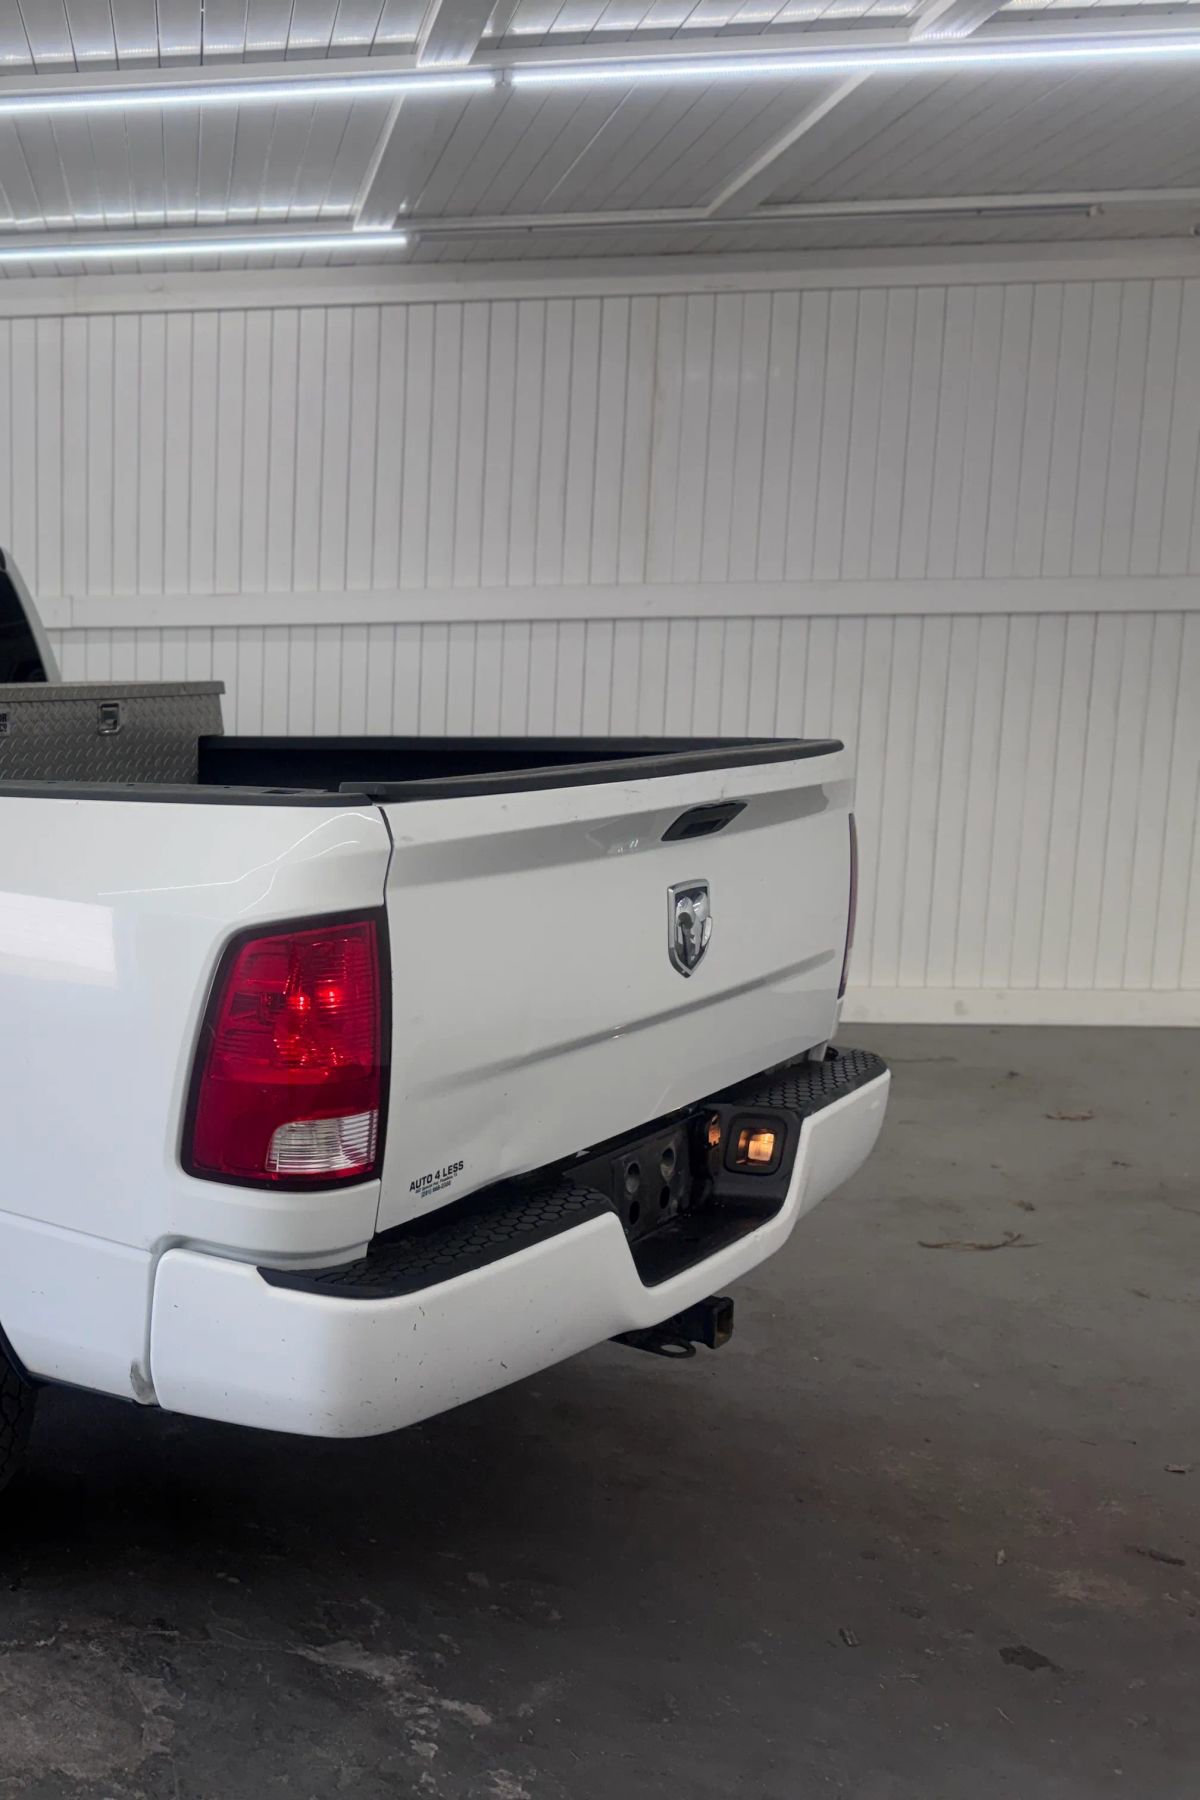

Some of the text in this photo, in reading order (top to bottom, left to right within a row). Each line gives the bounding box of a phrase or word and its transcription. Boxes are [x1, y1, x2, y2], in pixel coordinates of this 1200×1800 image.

[409, 1173, 433, 1192] AUTO
[435, 1170, 440, 1179] 4
[442, 1160, 464, 1177] LESS
